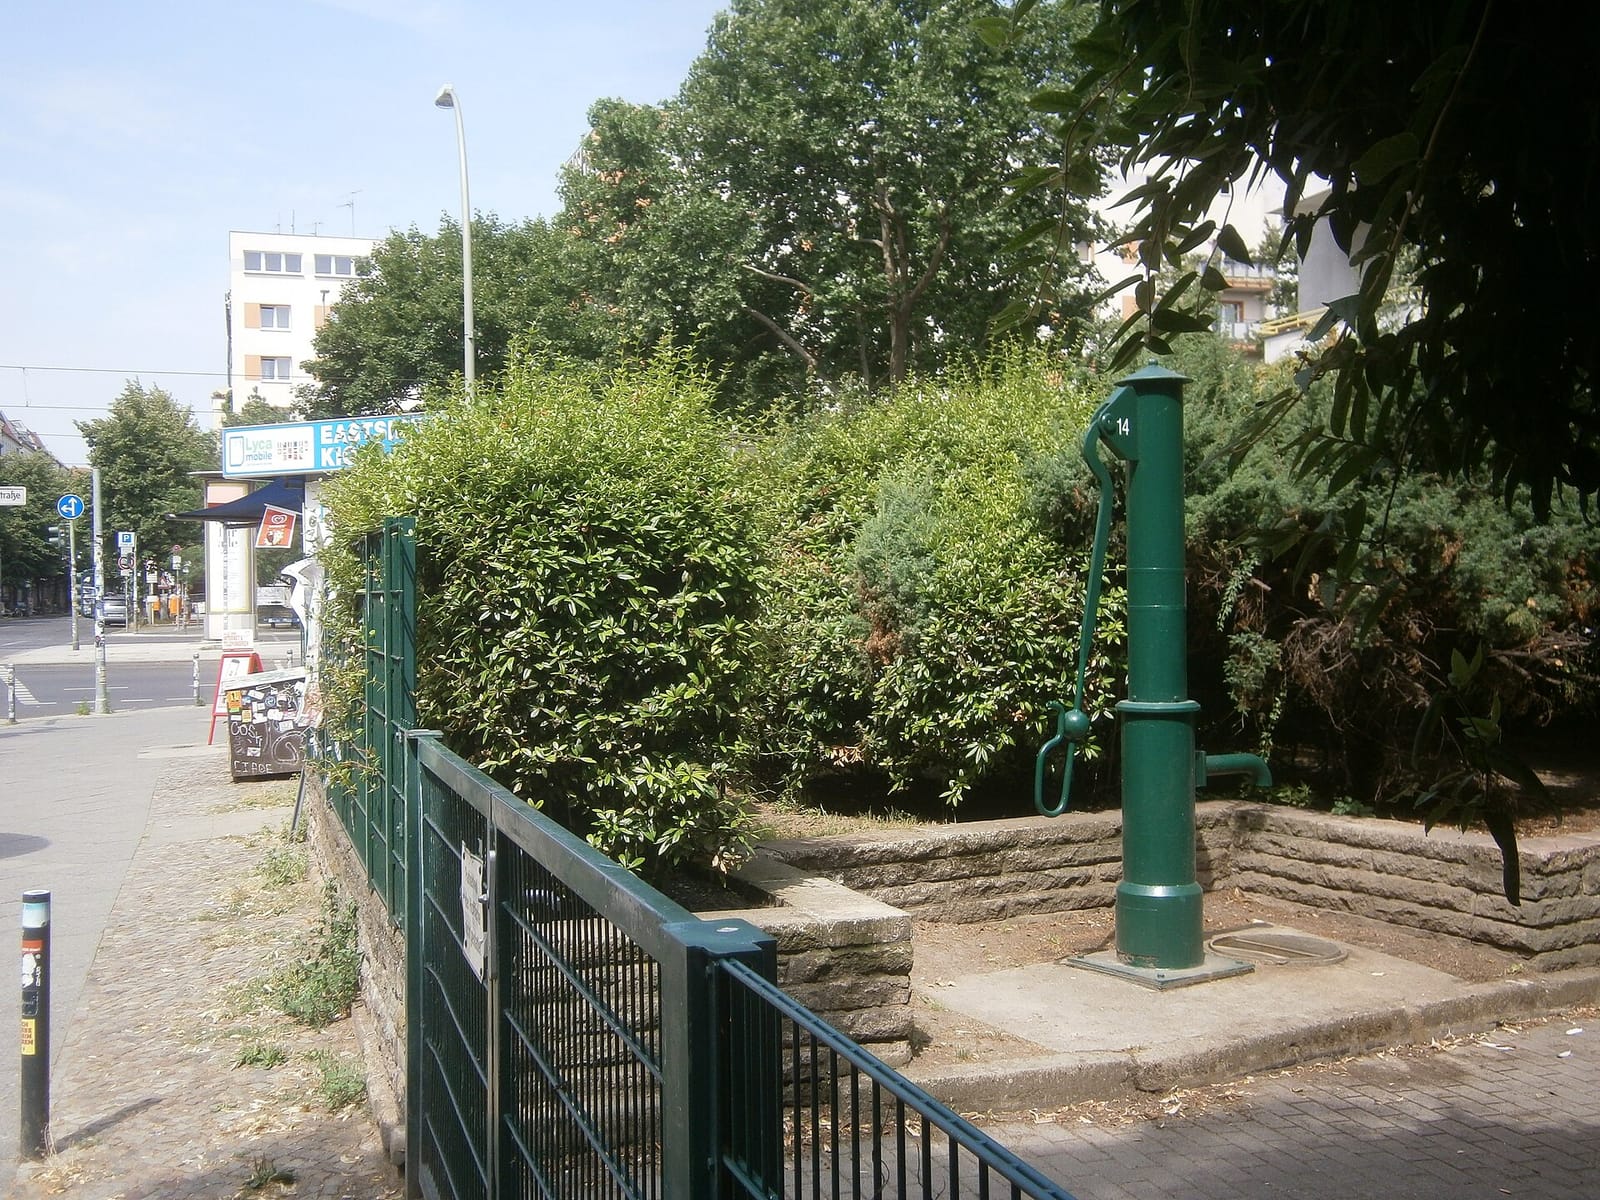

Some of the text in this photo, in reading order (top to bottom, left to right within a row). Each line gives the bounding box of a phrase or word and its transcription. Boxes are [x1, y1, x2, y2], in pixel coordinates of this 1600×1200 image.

[320, 416, 418, 445] EASTSI
[1116, 417, 1130, 436] 14
[245, 437, 273, 454] Lyca
[245, 451, 273, 462] mobile
[320, 445, 358, 468] KIO
